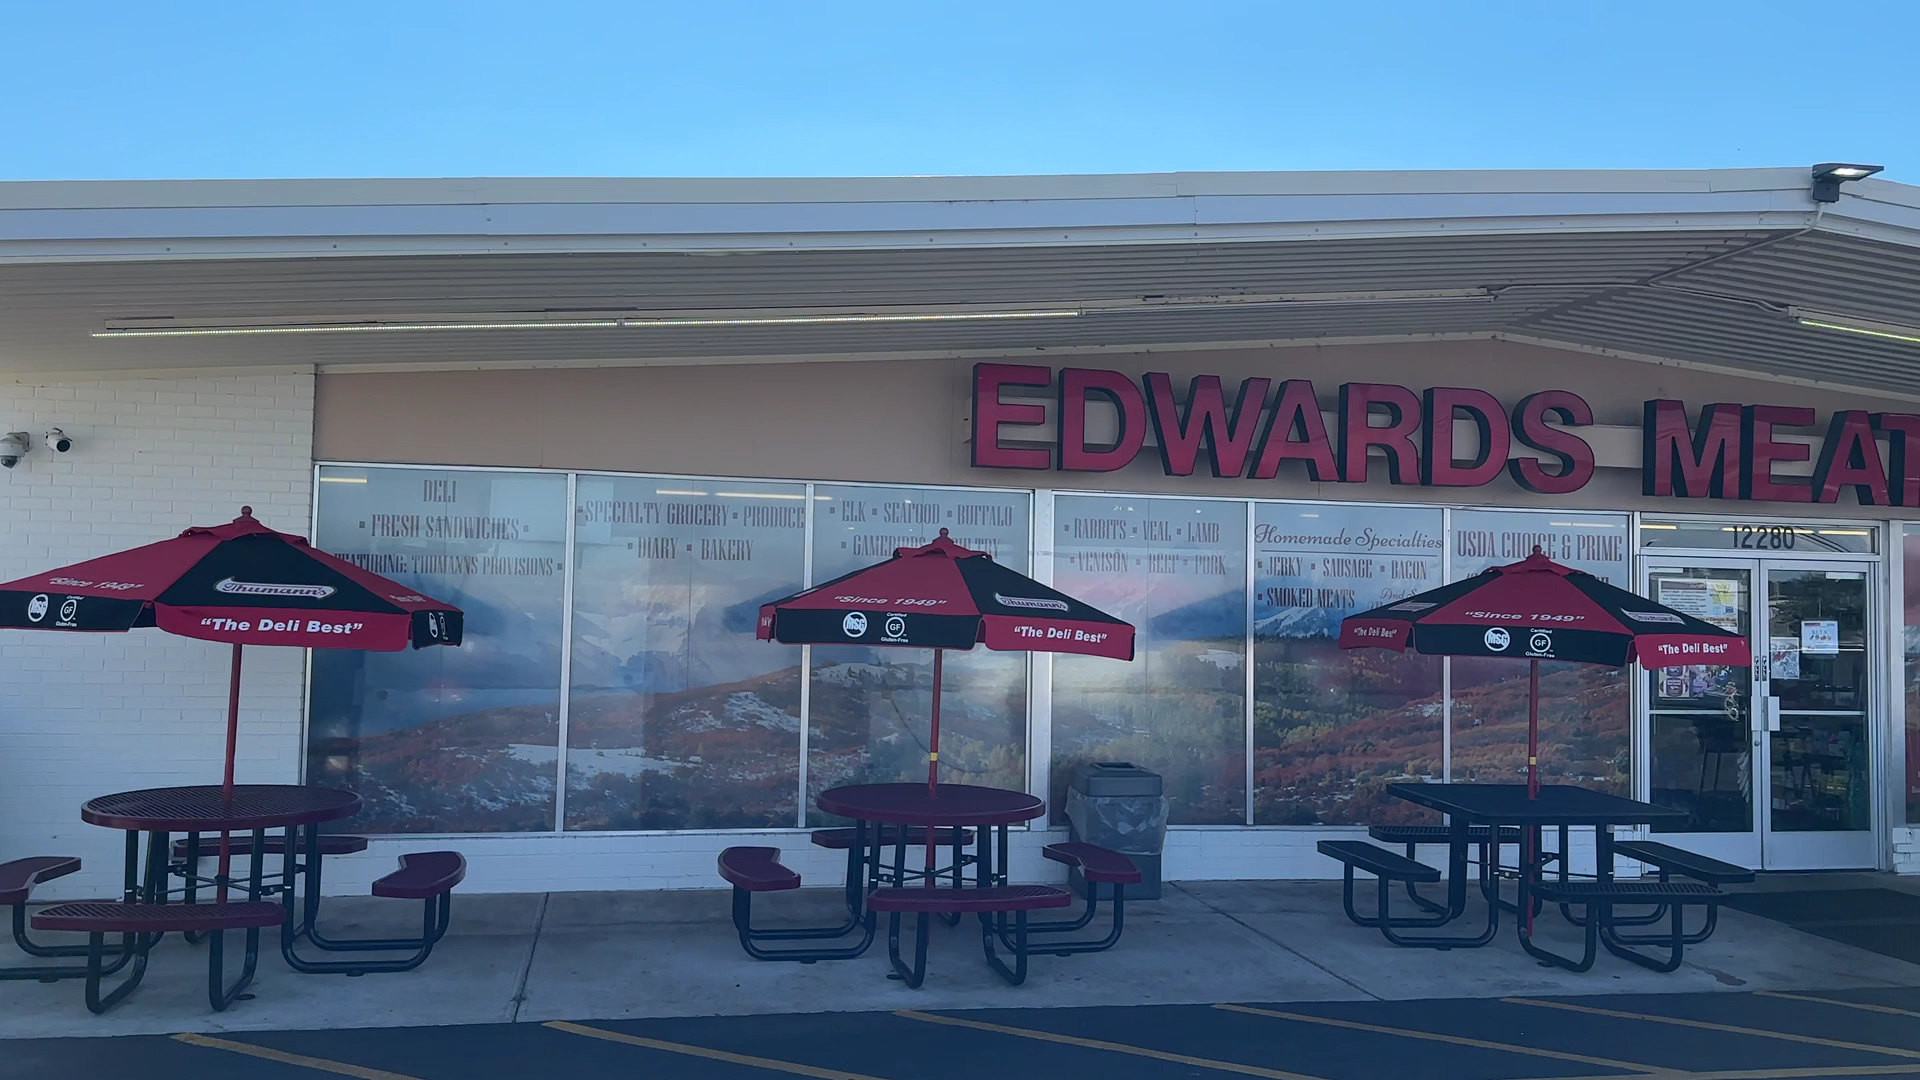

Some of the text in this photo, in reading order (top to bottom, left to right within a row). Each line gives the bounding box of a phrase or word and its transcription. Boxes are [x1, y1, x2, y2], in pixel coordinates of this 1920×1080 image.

[971, 363, 1595, 495] EDWARDS
[423, 479, 457, 503] DELI
[585, 500, 805, 529] SPECIALTY GROCERY PRODUCE
[841, 500, 1013, 527] ELK SEAFOOD BUFFALO
[371, 514, 520, 540] FRESH SANDWICHES
[1073, 517, 1220, 543] RABBITS VEAL LAMB
[1255, 524, 1442, 551] Homemade Specialties
[1732, 525, 1795, 549] 12280
[637, 536, 754, 561] DIARY BAKERY
[1457, 530, 1623, 562] USDA CHOICE & PRIME
[334, 553, 407, 574] ATURING:
[483, 557, 553, 577] PROVISIONS
[1078, 550, 1226, 576] VENISON BEEF PORK
[1266, 556, 1427, 580] JERKY SAUSAGE BACON
[63, 606, 73, 614] GF
[1266, 587, 1313, 608] SMOKED
[1317, 588, 1355, 609] MEATS
[257, 618, 300, 632] Deli
[889, 623, 901, 631] GF
[1047, 627, 1072, 640] Deli
[1534, 639, 1547, 647] GF
[1682, 643, 1700, 654] Deli
